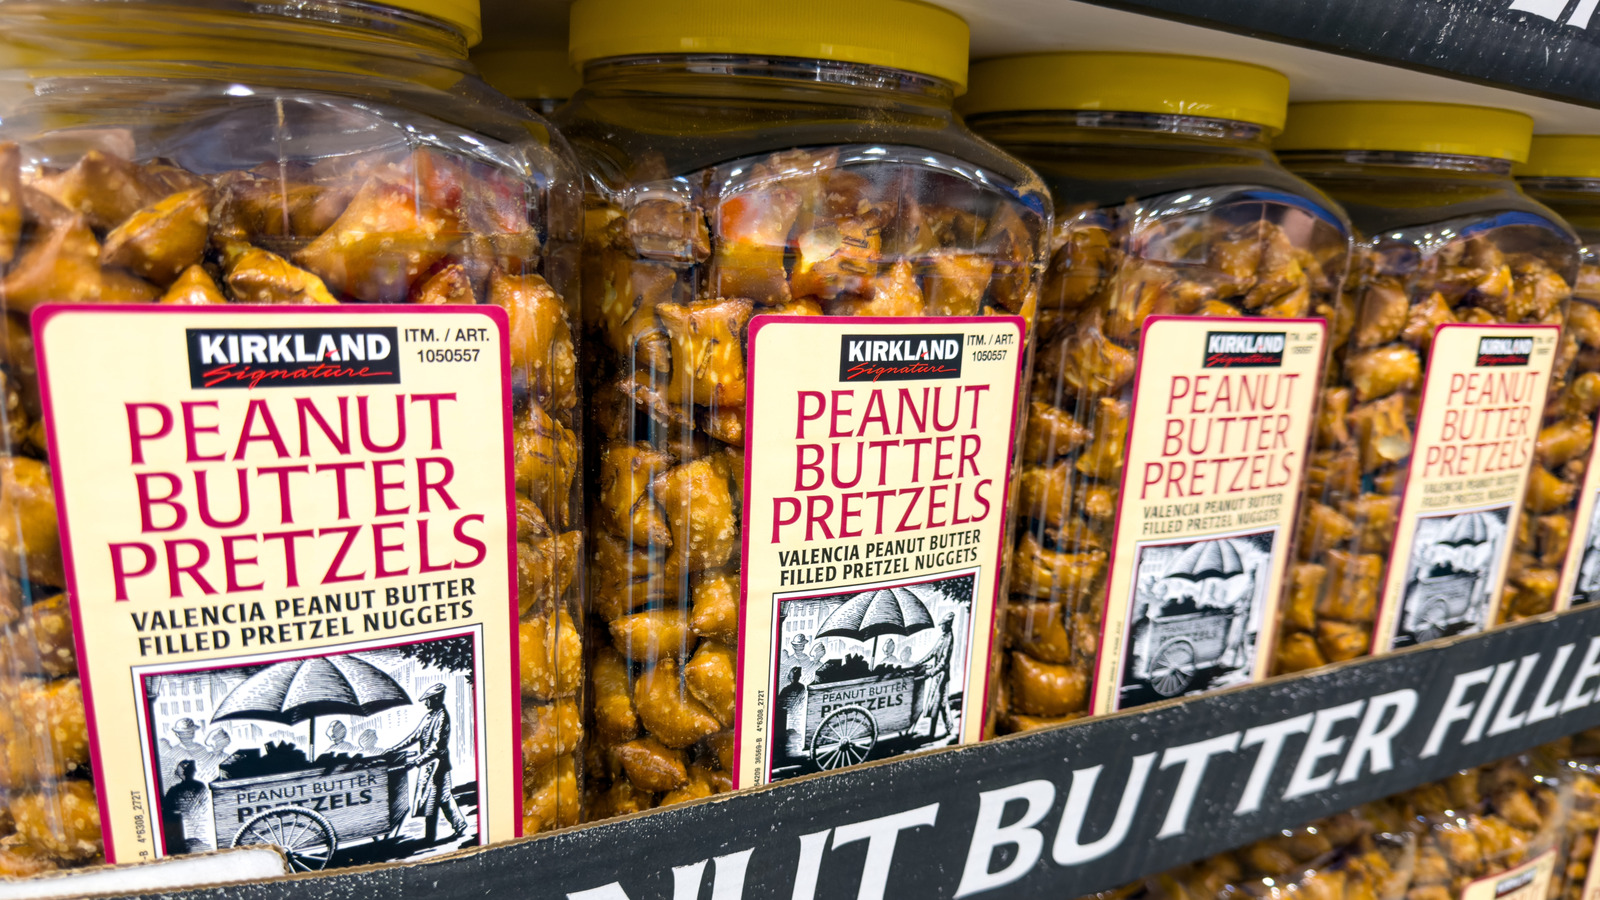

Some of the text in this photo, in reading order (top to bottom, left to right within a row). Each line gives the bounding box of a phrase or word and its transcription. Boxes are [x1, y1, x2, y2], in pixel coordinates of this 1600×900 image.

[200, 334, 391, 364] KIRKLAND
[404, 328, 490, 342] ITM. / ART.
[849, 339, 959, 362] KIRKLAND
[967, 335, 986, 346] ITM.
[994, 334, 1014, 345] ART.
[1208, 334, 1284, 353] KIRKLAND
[417, 349, 480, 363] 1050557
[847, 362, 957, 383] Signature
[972, 350, 1007, 362] 1050557
[202, 363, 393, 390] Signature
[1166, 373, 1300, 415] PEANUT
[1447, 371, 1540, 405] PEANUT
[124, 392, 458, 465] PEANUT
[795, 384, 990, 439] PEANUT
[1440, 406, 1531, 442] BUTTER
[1161, 414, 1292, 458] BUTTER
[794, 434, 982, 492] BUTTER
[1139, 452, 1294, 500] PRETZELS
[1422, 438, 1531, 477] PRETZELS
[134, 456, 460, 534] BUTTER
[770, 478, 994, 544] PRETZELS
[1143, 503, 1200, 519] VALENCIA
[1204, 498, 1246, 513] PEANUT
[1142, 520, 1183, 535] FILLED
[107, 513, 488, 602] PRETZELS
[778, 529, 981, 567] VALENCIA PEANUT BUTTER
[780, 547, 977, 586] FILLED PRETZEL NUGGETS
[130, 577, 476, 632] VALENCIA PEANUT BUTTER
[138, 600, 474, 657] FILLED PRETZEL NUGGETS
[822, 681, 907, 703] PEANUT BUTTER
[953, 689, 1419, 900] BUTTER
[1418, 636, 1600, 760] FILLE
[237, 774, 377, 804] PEANUT BUTTER
